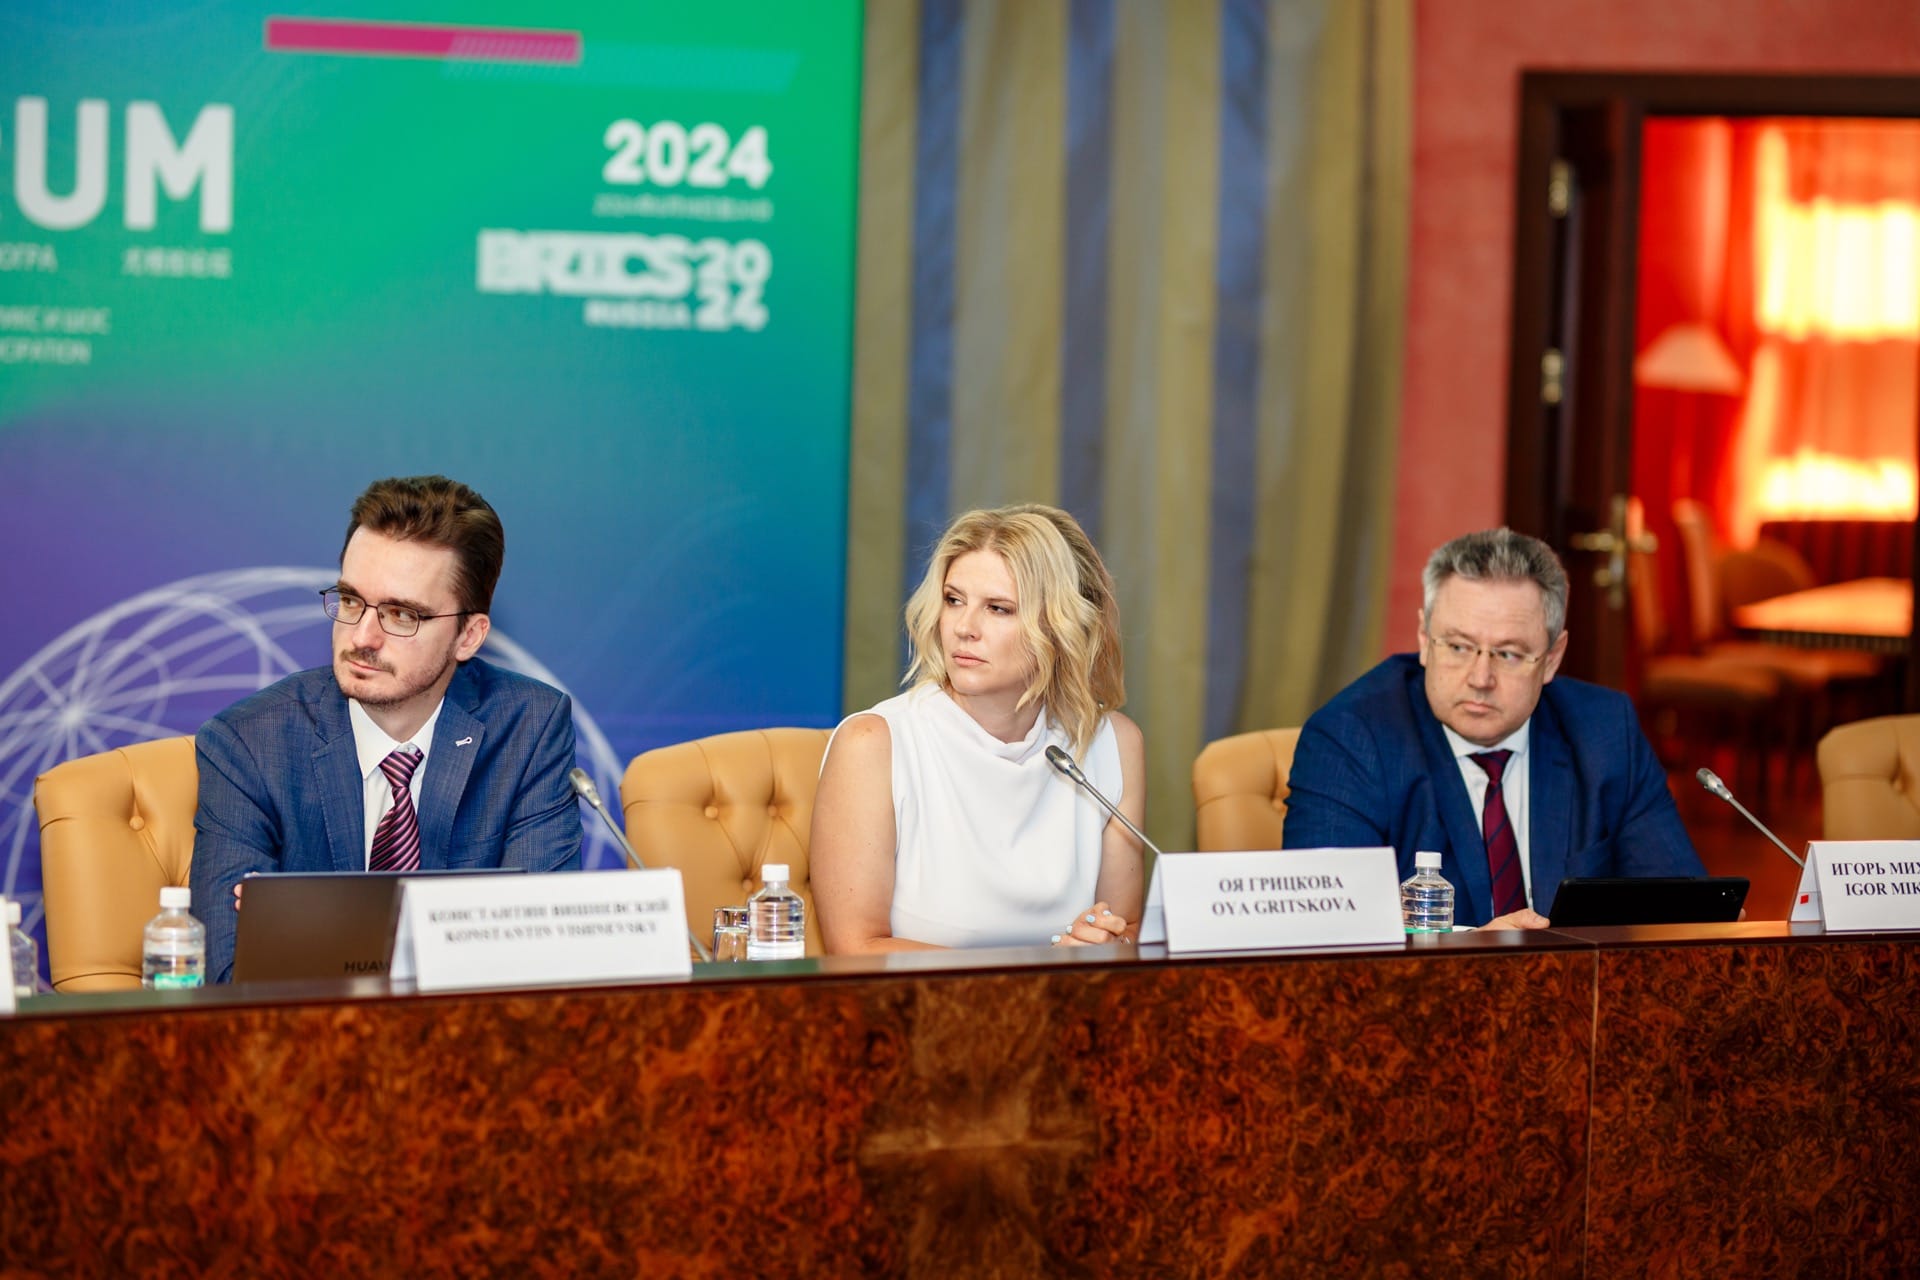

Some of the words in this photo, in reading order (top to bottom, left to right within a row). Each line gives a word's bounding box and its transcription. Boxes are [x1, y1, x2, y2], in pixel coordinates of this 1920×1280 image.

[0, 95, 235, 234] UM
[602, 117, 774, 190] 2024
[695, 237, 773, 284] 20
[695, 282, 770, 332] 24
[1219, 878, 1244, 892] ОЯ
[1250, 875, 1344, 893] ГРИЦКОВА
[1832, 862, 1886, 876] ИГОРЬ
[1845, 882, 1888, 896] IGOR
[1211, 901, 1250, 916] OYA
[1254, 898, 1357, 915] GRITSKOVA
